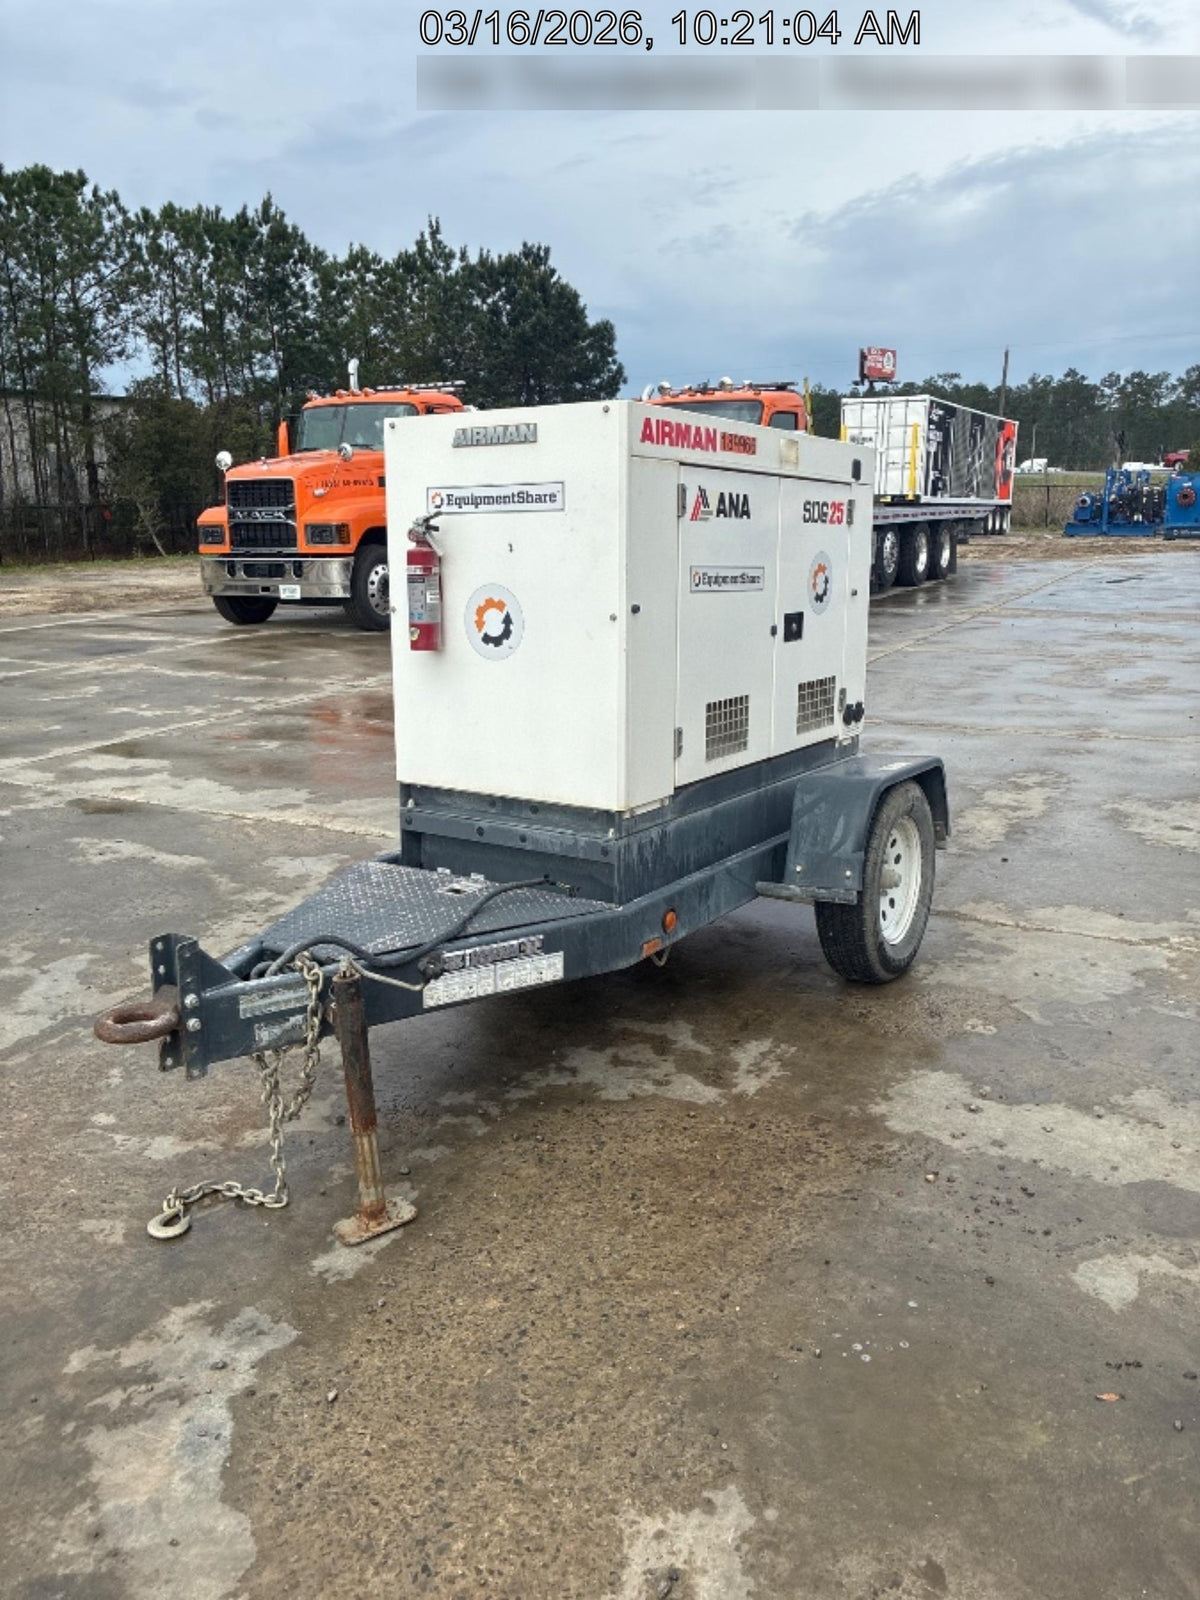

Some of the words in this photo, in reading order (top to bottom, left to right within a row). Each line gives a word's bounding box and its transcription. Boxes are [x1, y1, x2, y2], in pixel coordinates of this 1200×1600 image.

[452, 422, 538, 448] AIRMAN
[640, 417, 718, 453] AIRMAN
[445, 490, 558, 510] EquipmentShare
[715, 491, 752, 520] ANA
[802, 499, 845, 526] SDG25
